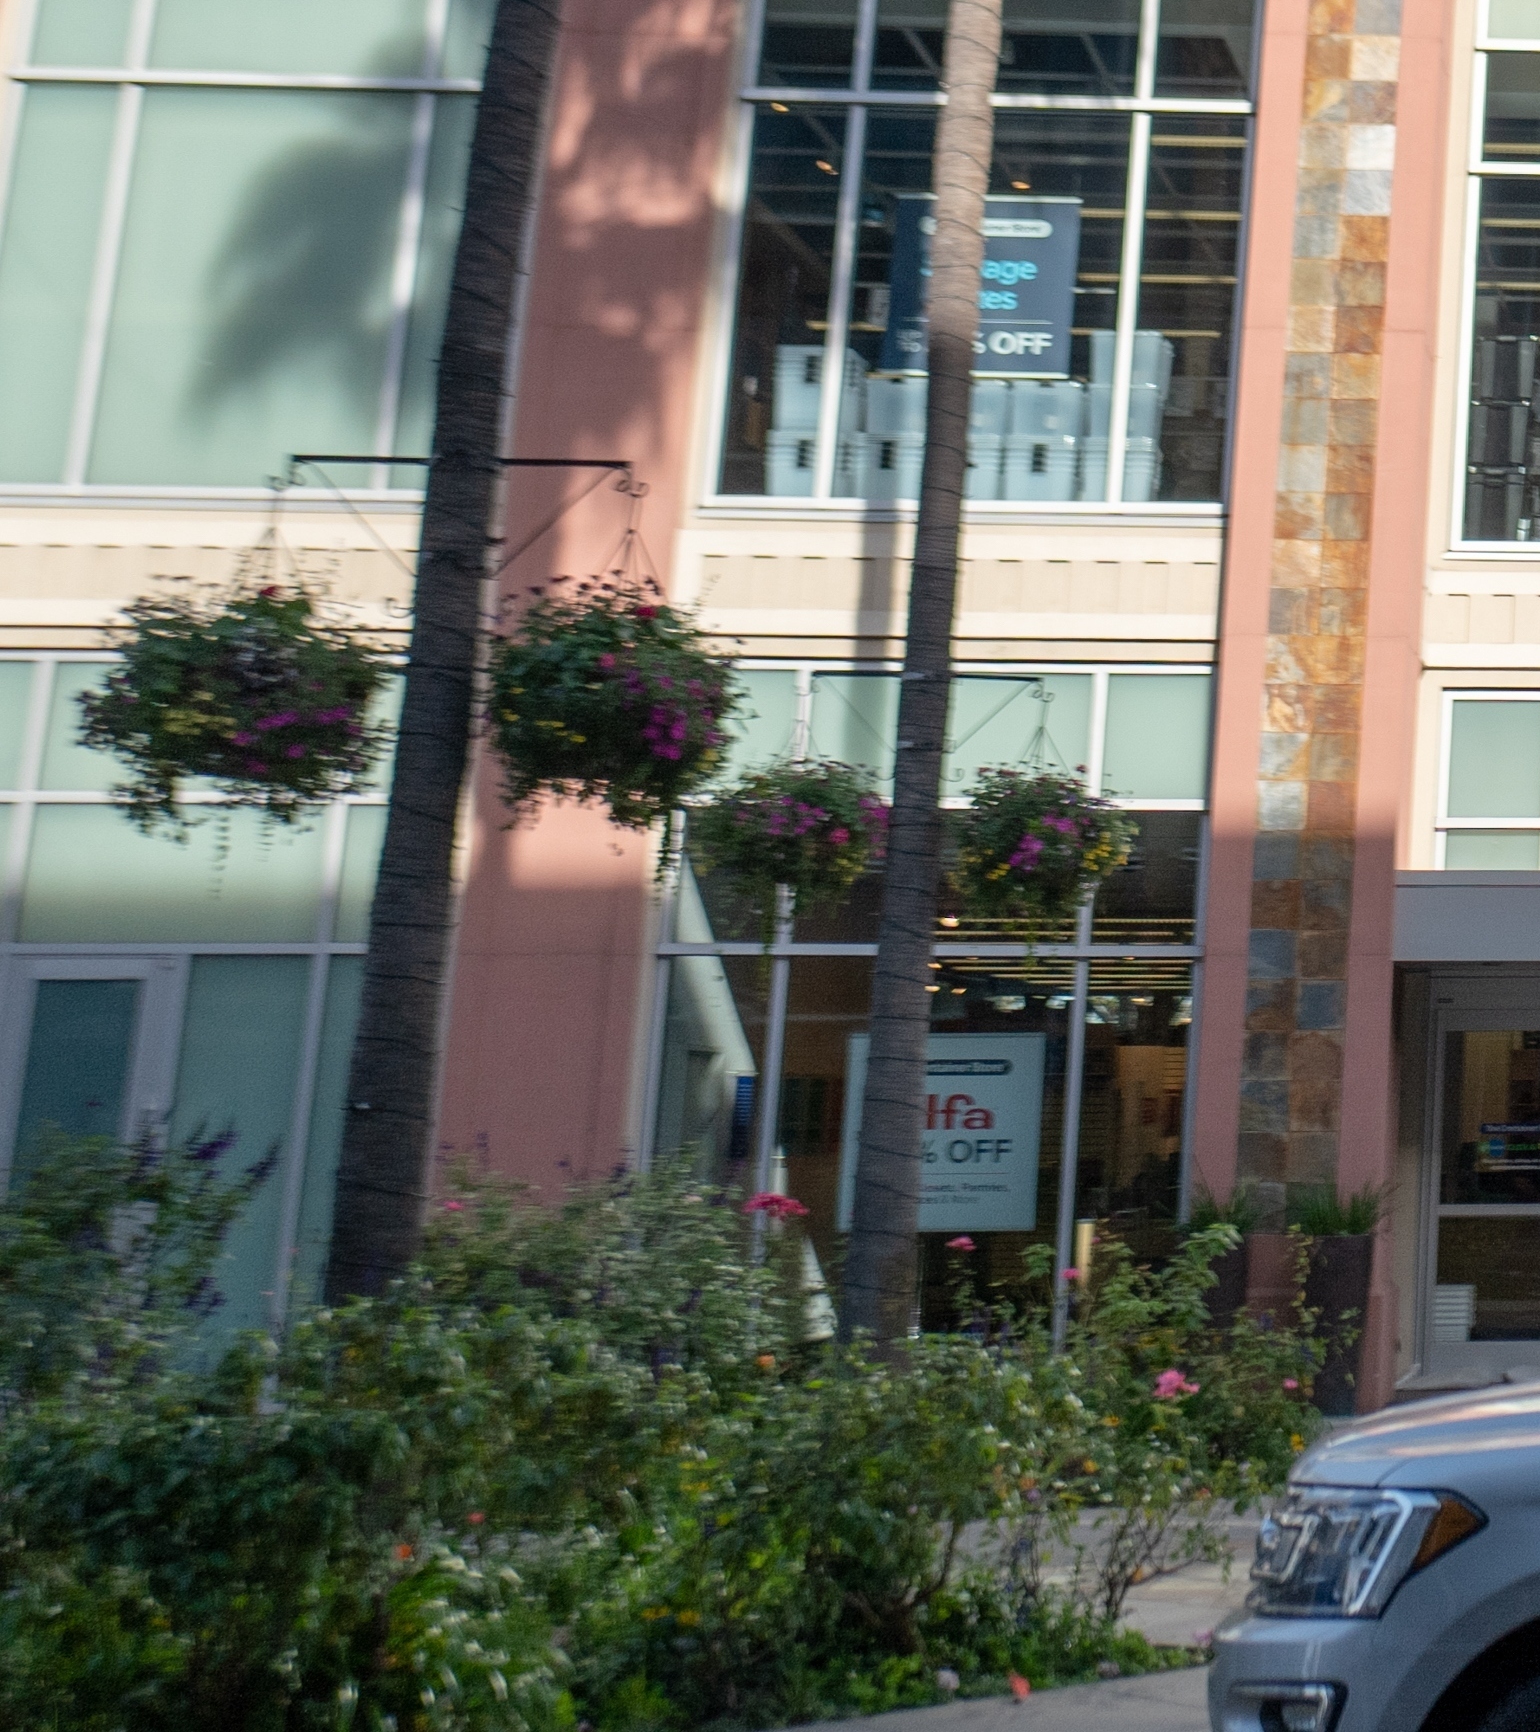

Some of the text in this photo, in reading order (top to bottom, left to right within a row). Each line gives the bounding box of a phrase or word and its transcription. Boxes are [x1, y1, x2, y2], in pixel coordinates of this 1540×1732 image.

[988, 331, 1053, 355] OFF
[925, 1094, 995, 1130] lfa
[946, 1139, 1013, 1163] OFF
